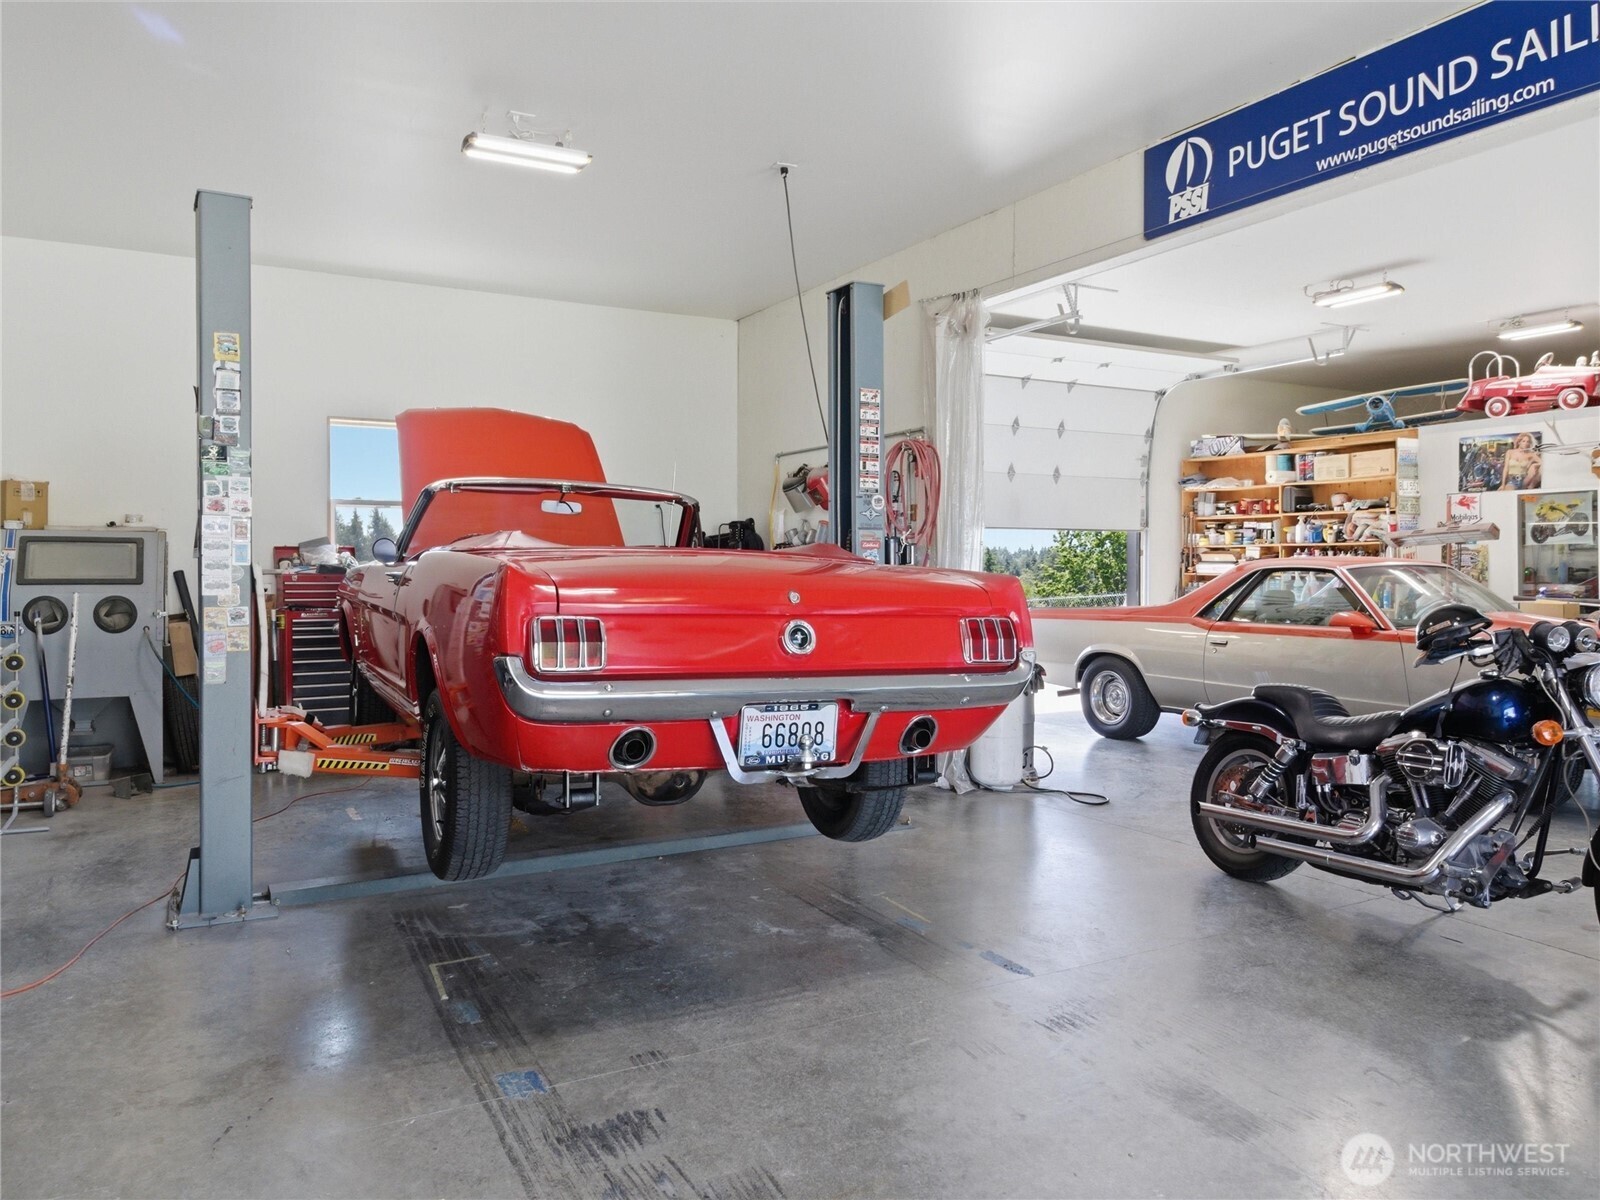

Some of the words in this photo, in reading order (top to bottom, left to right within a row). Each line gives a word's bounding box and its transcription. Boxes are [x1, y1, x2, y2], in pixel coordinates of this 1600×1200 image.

[1228, 109, 1331, 178] PUGET
[1338, 56, 1478, 136] SOUND
[1490, 3, 1599, 80] SAILI
[1316, 77, 1555, 171] www.pugetsoundsailing.com
[1168, 184, 1209, 223] PSSI
[746, 713, 801, 722] WASHINGTON
[765, 752, 829, 764] MUSG
